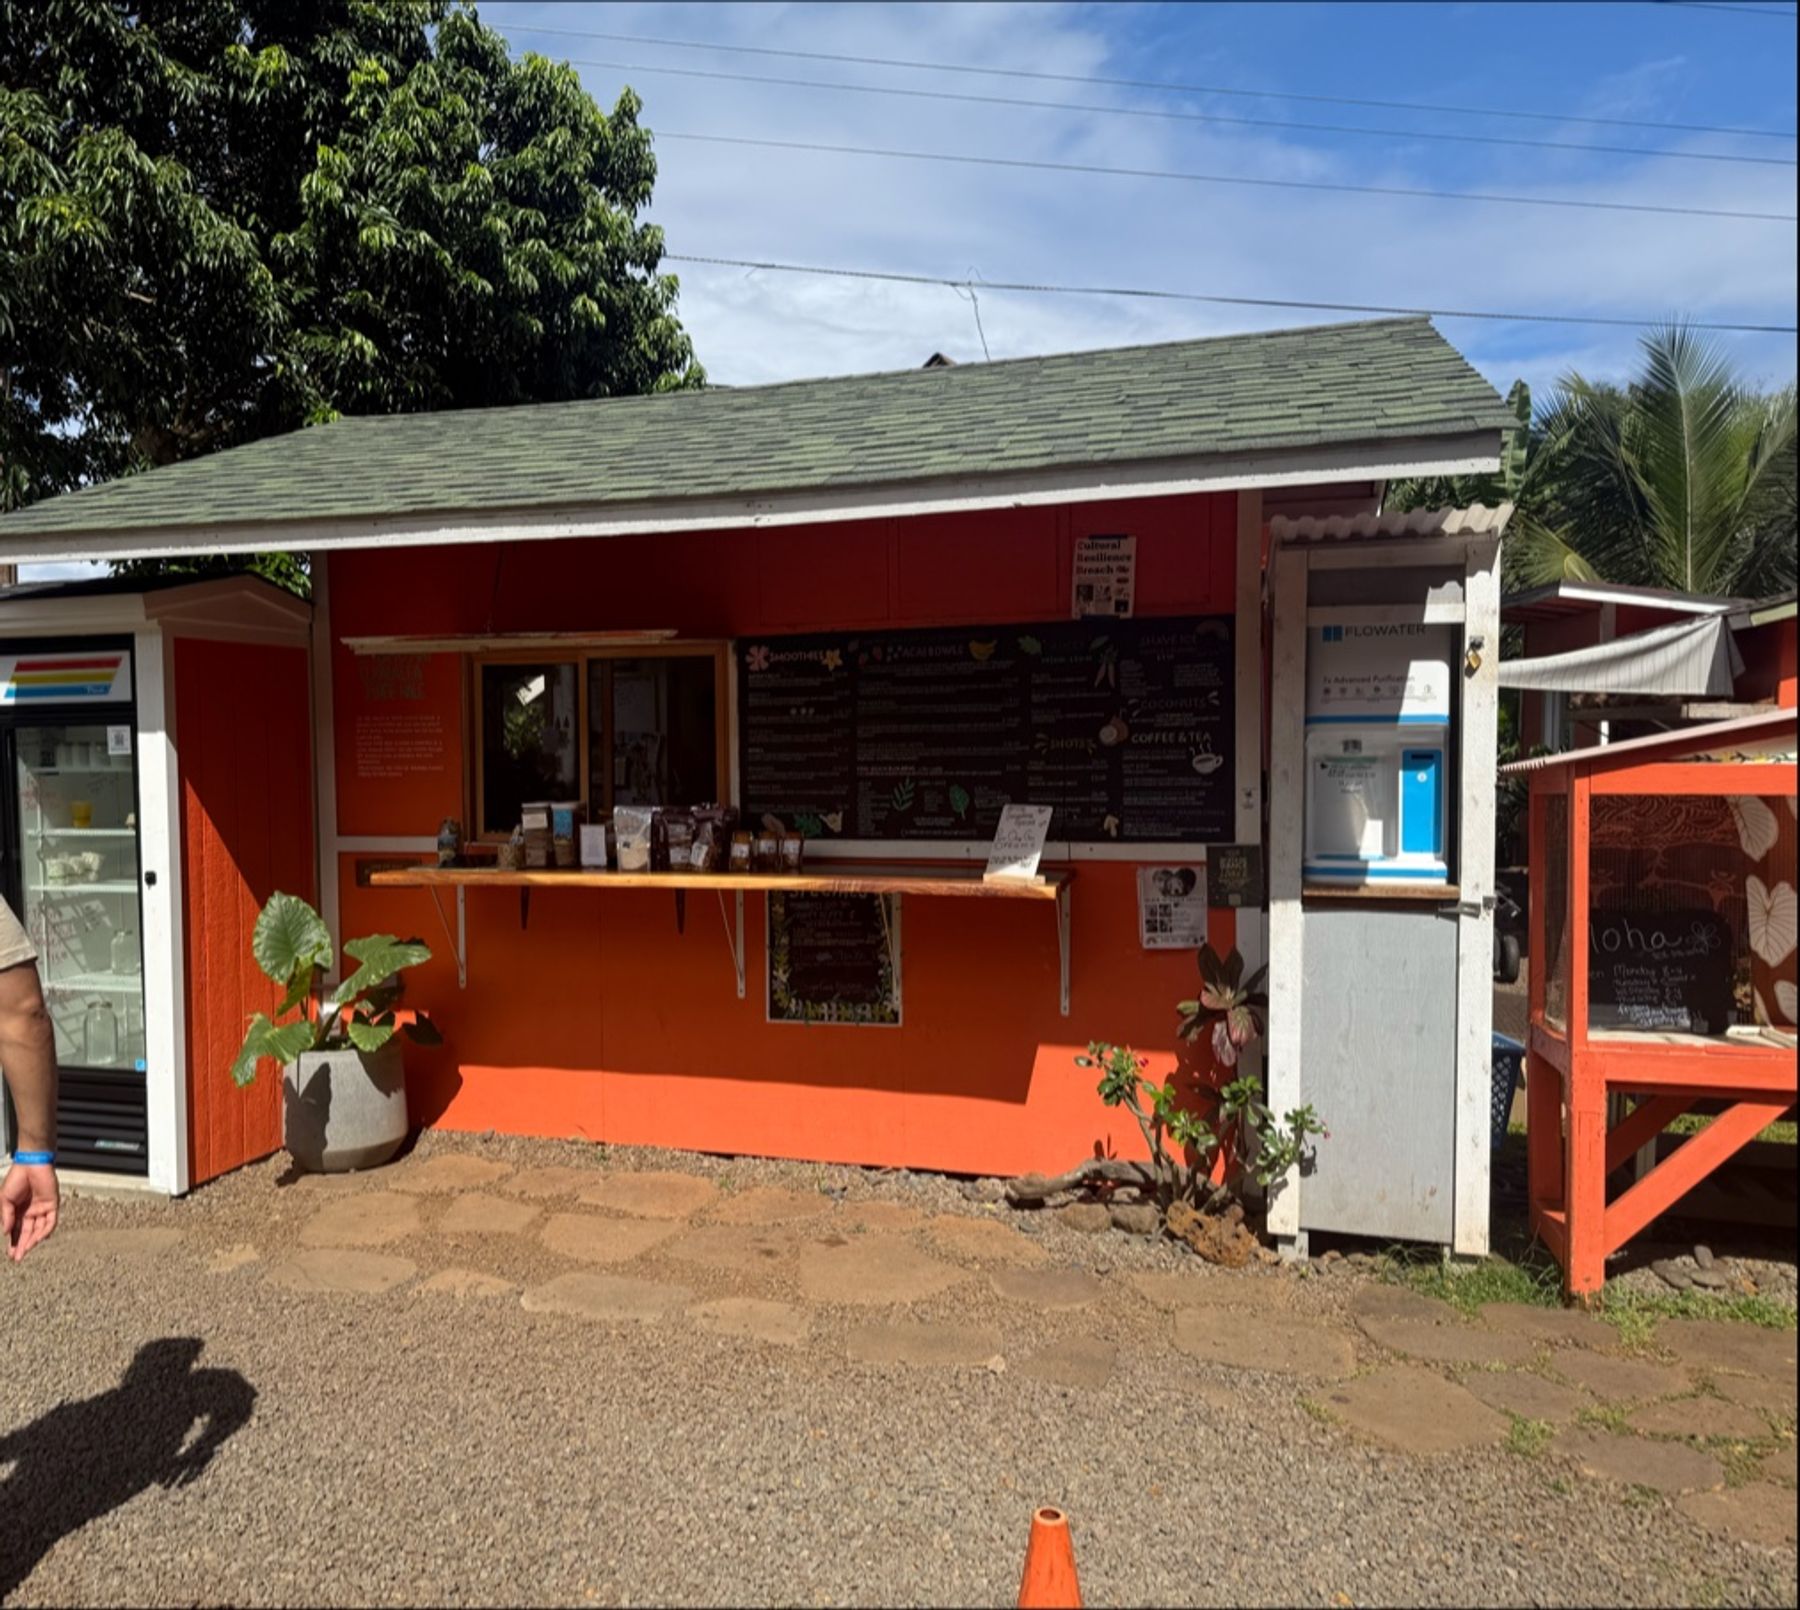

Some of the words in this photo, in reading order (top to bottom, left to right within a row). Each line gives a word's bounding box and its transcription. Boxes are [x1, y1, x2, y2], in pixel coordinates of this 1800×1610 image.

[1077, 541, 1121, 551] Cultural
[1077, 553, 1132, 563] Resilience
[1345, 624, 1426, 637] FLOWATER
[769, 650, 824, 664] SMOOTHIES
[1140, 697, 1207, 710] COCONUTS
[1050, 737, 1085, 749] SHOTS
[1131, 732, 1175, 743] COFFEE
[1178, 732, 1187, 743] &
[1188, 731, 1212, 742] TEA
[1590, 918, 1683, 954] loha
